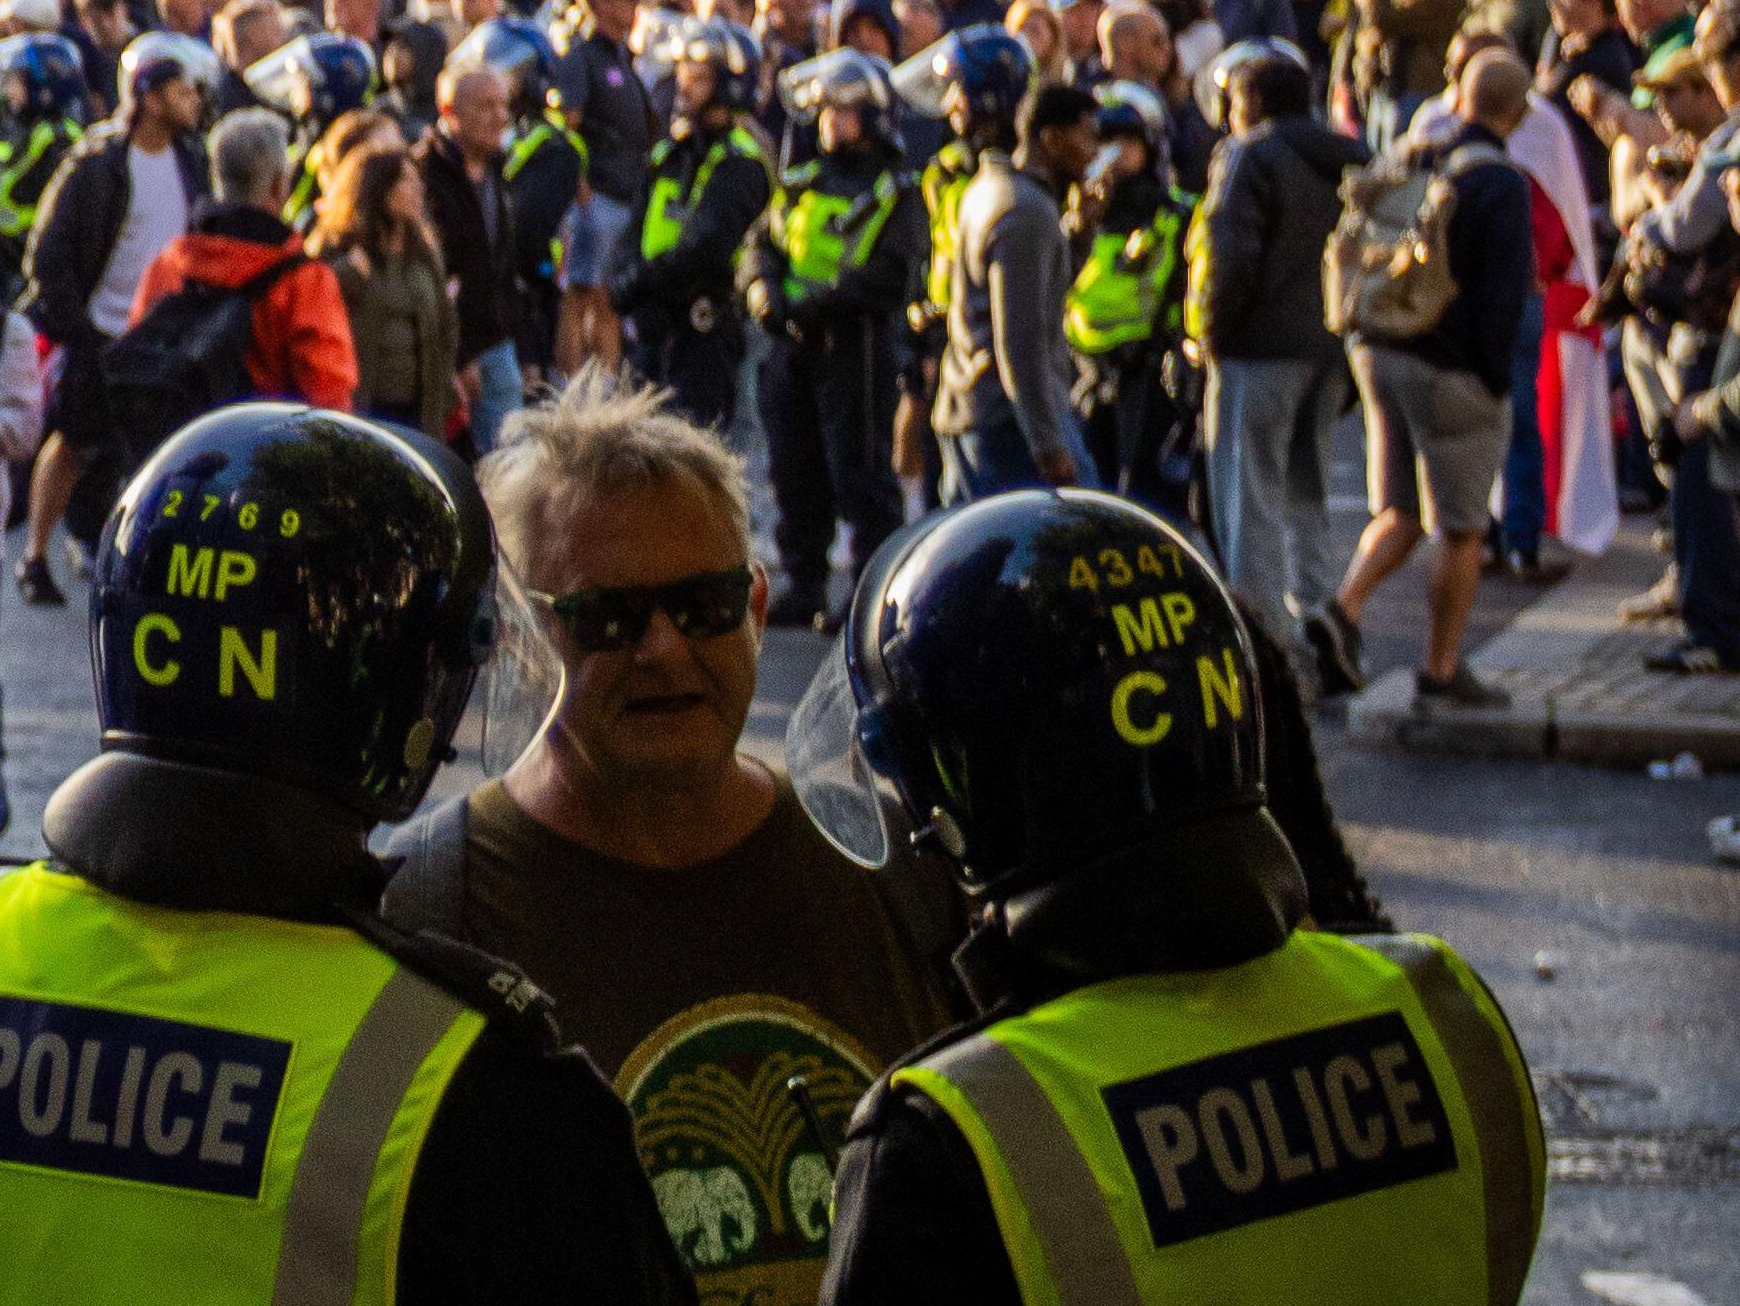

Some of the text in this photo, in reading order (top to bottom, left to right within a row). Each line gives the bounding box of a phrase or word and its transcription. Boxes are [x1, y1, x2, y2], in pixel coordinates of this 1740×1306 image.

[163, 488, 301, 539] 2769
[166, 543, 258, 603] MP
[1068, 544, 1185, 592] 4347
[1110, 590, 1197, 658] MP
[1134, 1041, 1438, 1214] POLICE
